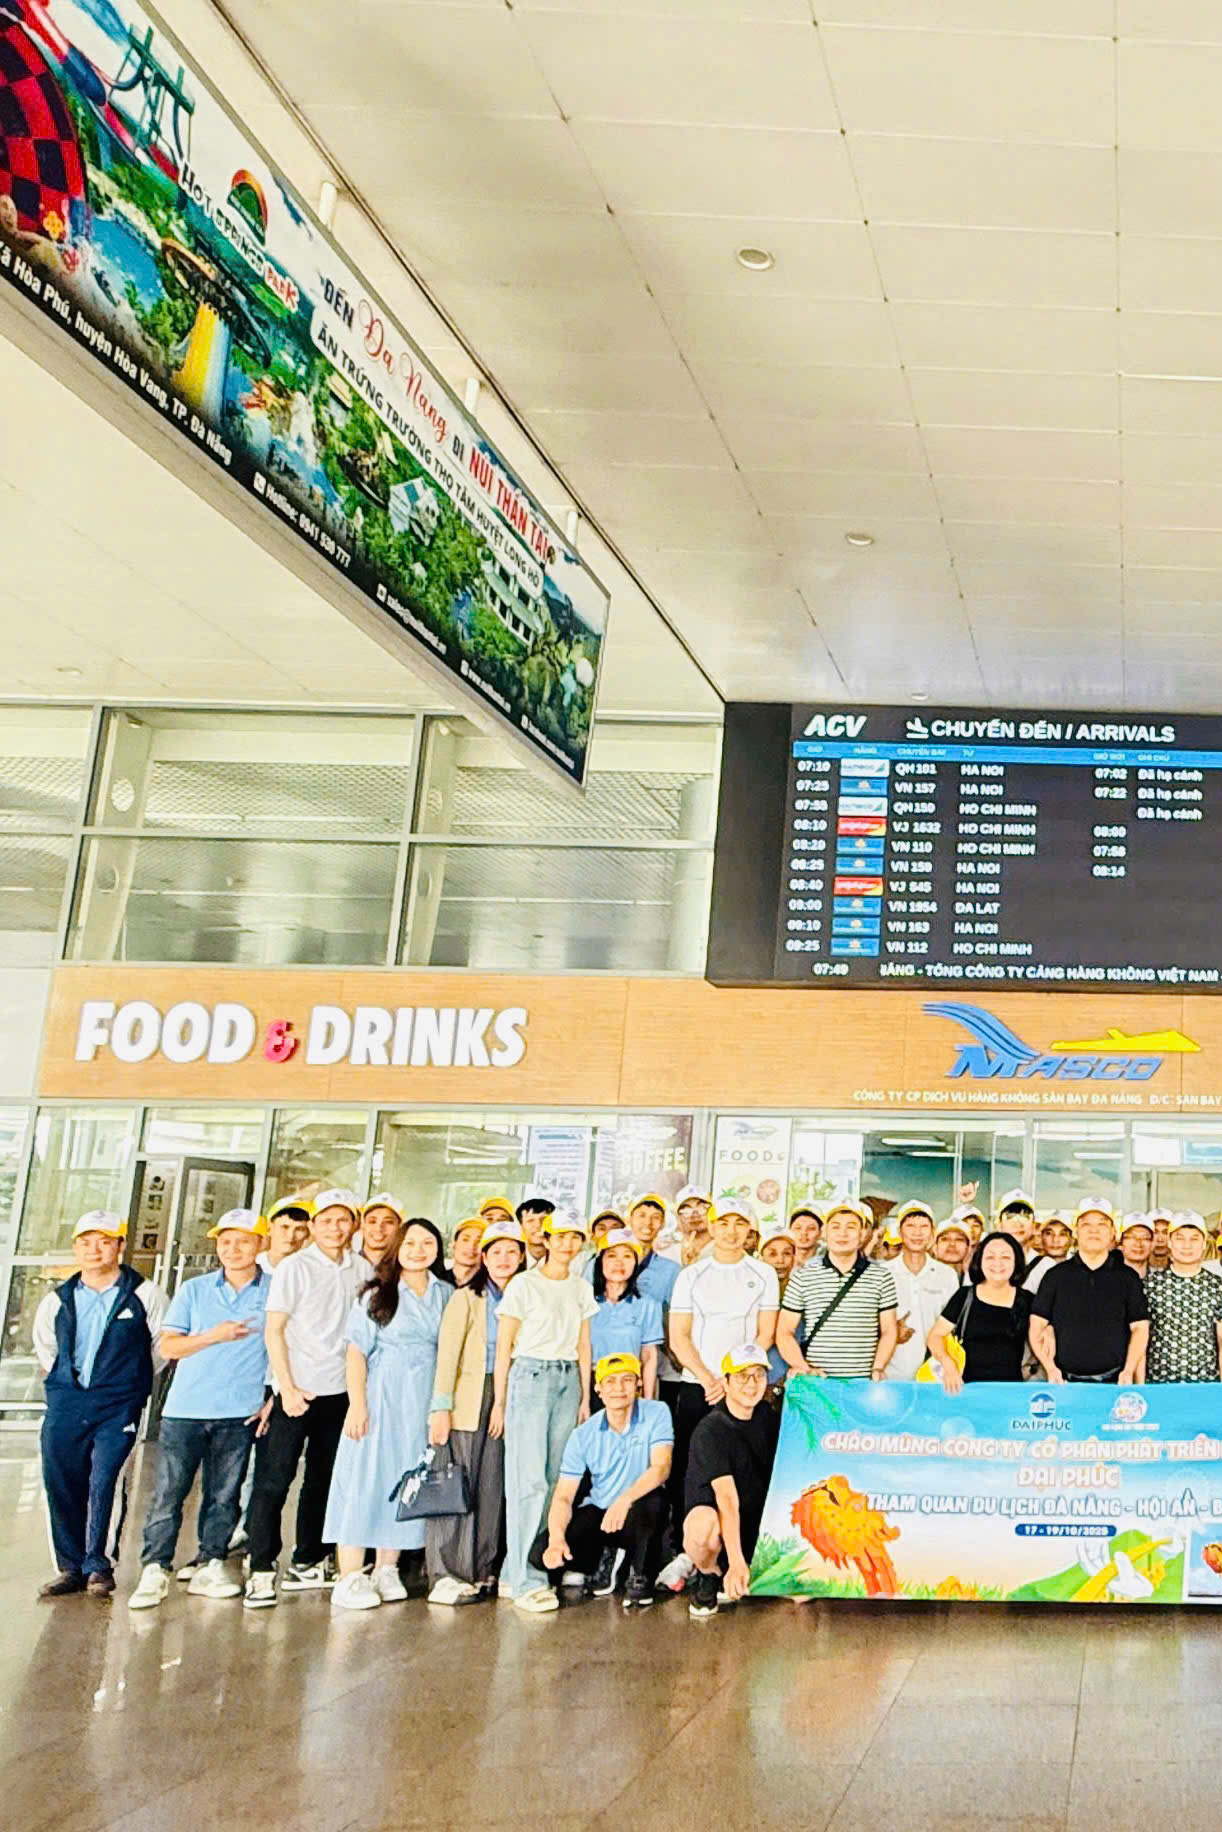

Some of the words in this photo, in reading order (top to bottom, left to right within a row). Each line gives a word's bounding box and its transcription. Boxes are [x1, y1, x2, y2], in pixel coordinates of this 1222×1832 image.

[180, 163, 213, 212] HOT
[13, 256, 41, 295] Hòa
[43, 283, 72, 324] Phú,
[75, 311, 112, 357] huyện
[113, 346, 138, 379] Hòa
[140, 368, 169, 410] Vang,
[172, 397, 188, 425] TP.
[322, 277, 355, 329] ĐẾN
[452, 435, 465, 462] ĐI
[469, 446, 494, 494] NÚI
[496, 478, 529, 537] THẦN
[317, 320, 338, 358] ĂN
[341, 350, 384, 410] TRỨNG
[386, 402, 432, 465] TRƯỜNG
[505, 541, 527, 575] LONG
[803, 713, 868, 738] ACV
[931, 718, 1014, 739] CHUYẾN
[1018, 719, 1062, 740] ĐẾN
[1076, 724, 1176, 743] ARRIVALS
[895, 763, 915, 776] QH
[961, 764, 979, 776] HA
[981, 765, 1004, 776] NOI
[894, 782, 913, 794] VN
[960, 784, 978, 795] HA
[980, 784, 1004, 796] NOI
[893, 802, 913, 815] QH
[959, 803, 979, 815] HO
[980, 803, 1003, 815] CHI
[1005, 804, 1037, 816] MINH
[893, 822, 909, 833] VJ
[958, 823, 978, 834] HO
[980, 823, 1002, 835] CHI
[1003, 824, 1036, 836] MINH
[891, 841, 910, 853] VN
[957, 843, 978, 854] HO
[979, 843, 1001, 855] CHI
[1002, 843, 1036, 855] MINH
[890, 861, 909, 873] VN
[956, 862, 976, 874] HA
[977, 862, 1000, 874] NOI
[889, 881, 906, 892] VJ
[955, 882, 975, 894] HA
[976, 883, 1000, 894] NOI
[887, 901, 907, 912] VN
[954, 902, 974, 914] DA
[975, 902, 1000, 914] LAT
[887, 921, 906, 932] VN
[954, 922, 973, 934] HA
[974, 922, 998, 934] NOI
[886, 941, 905, 953] VN
[953, 942, 974, 955] HO
[974, 942, 998, 955] CHI
[999, 943, 1033, 955] MINH
[925, 963, 964, 978] TỔNG
[965, 963, 1006, 978] CÔNG
[1007, 966, 1025, 978] TY
[1107, 965, 1155, 981] KHÔNG
[1157, 967, 1187, 983] VIỆT
[1187, 969, 1219, 982] NAM
[75, 999, 257, 1064] FOOD
[264, 1018, 298, 1063] &
[305, 1004, 529, 1068] DRINKS
[945, 1044, 1165, 1081] MASCO
[888, 1091, 903, 1102] TY
[906, 1091, 921, 1102] CP
[1066, 1093, 1089, 1105] BAY
[1200, 1094, 1222, 1107] BAY
[820, 1430, 878, 1455] CHÀO
[879, 1433, 942, 1457] MỪNG
[943, 1435, 999, 1458] CÔNG
[1000, 1439, 1027, 1459] TY
[1030, 1434, 1059, 1459] CỔ
[1061, 1436, 1115, 1461] PHẦN
[1165, 1432, 1221, 1459] TRIỂN
[1016, 1466, 1058, 1492] ĐẠI
[1061, 1462, 1122, 1489] PHÚC
[866, 1493, 917, 1515] THAM
[920, 1494, 973, 1515] QUAN
[975, 1496, 997, 1515] DU
[1000, 1497, 1040, 1520] LỊCH
[1042, 1493, 1068, 1517] ĐÀ
[1135, 1497, 1167, 1520] HỘI
